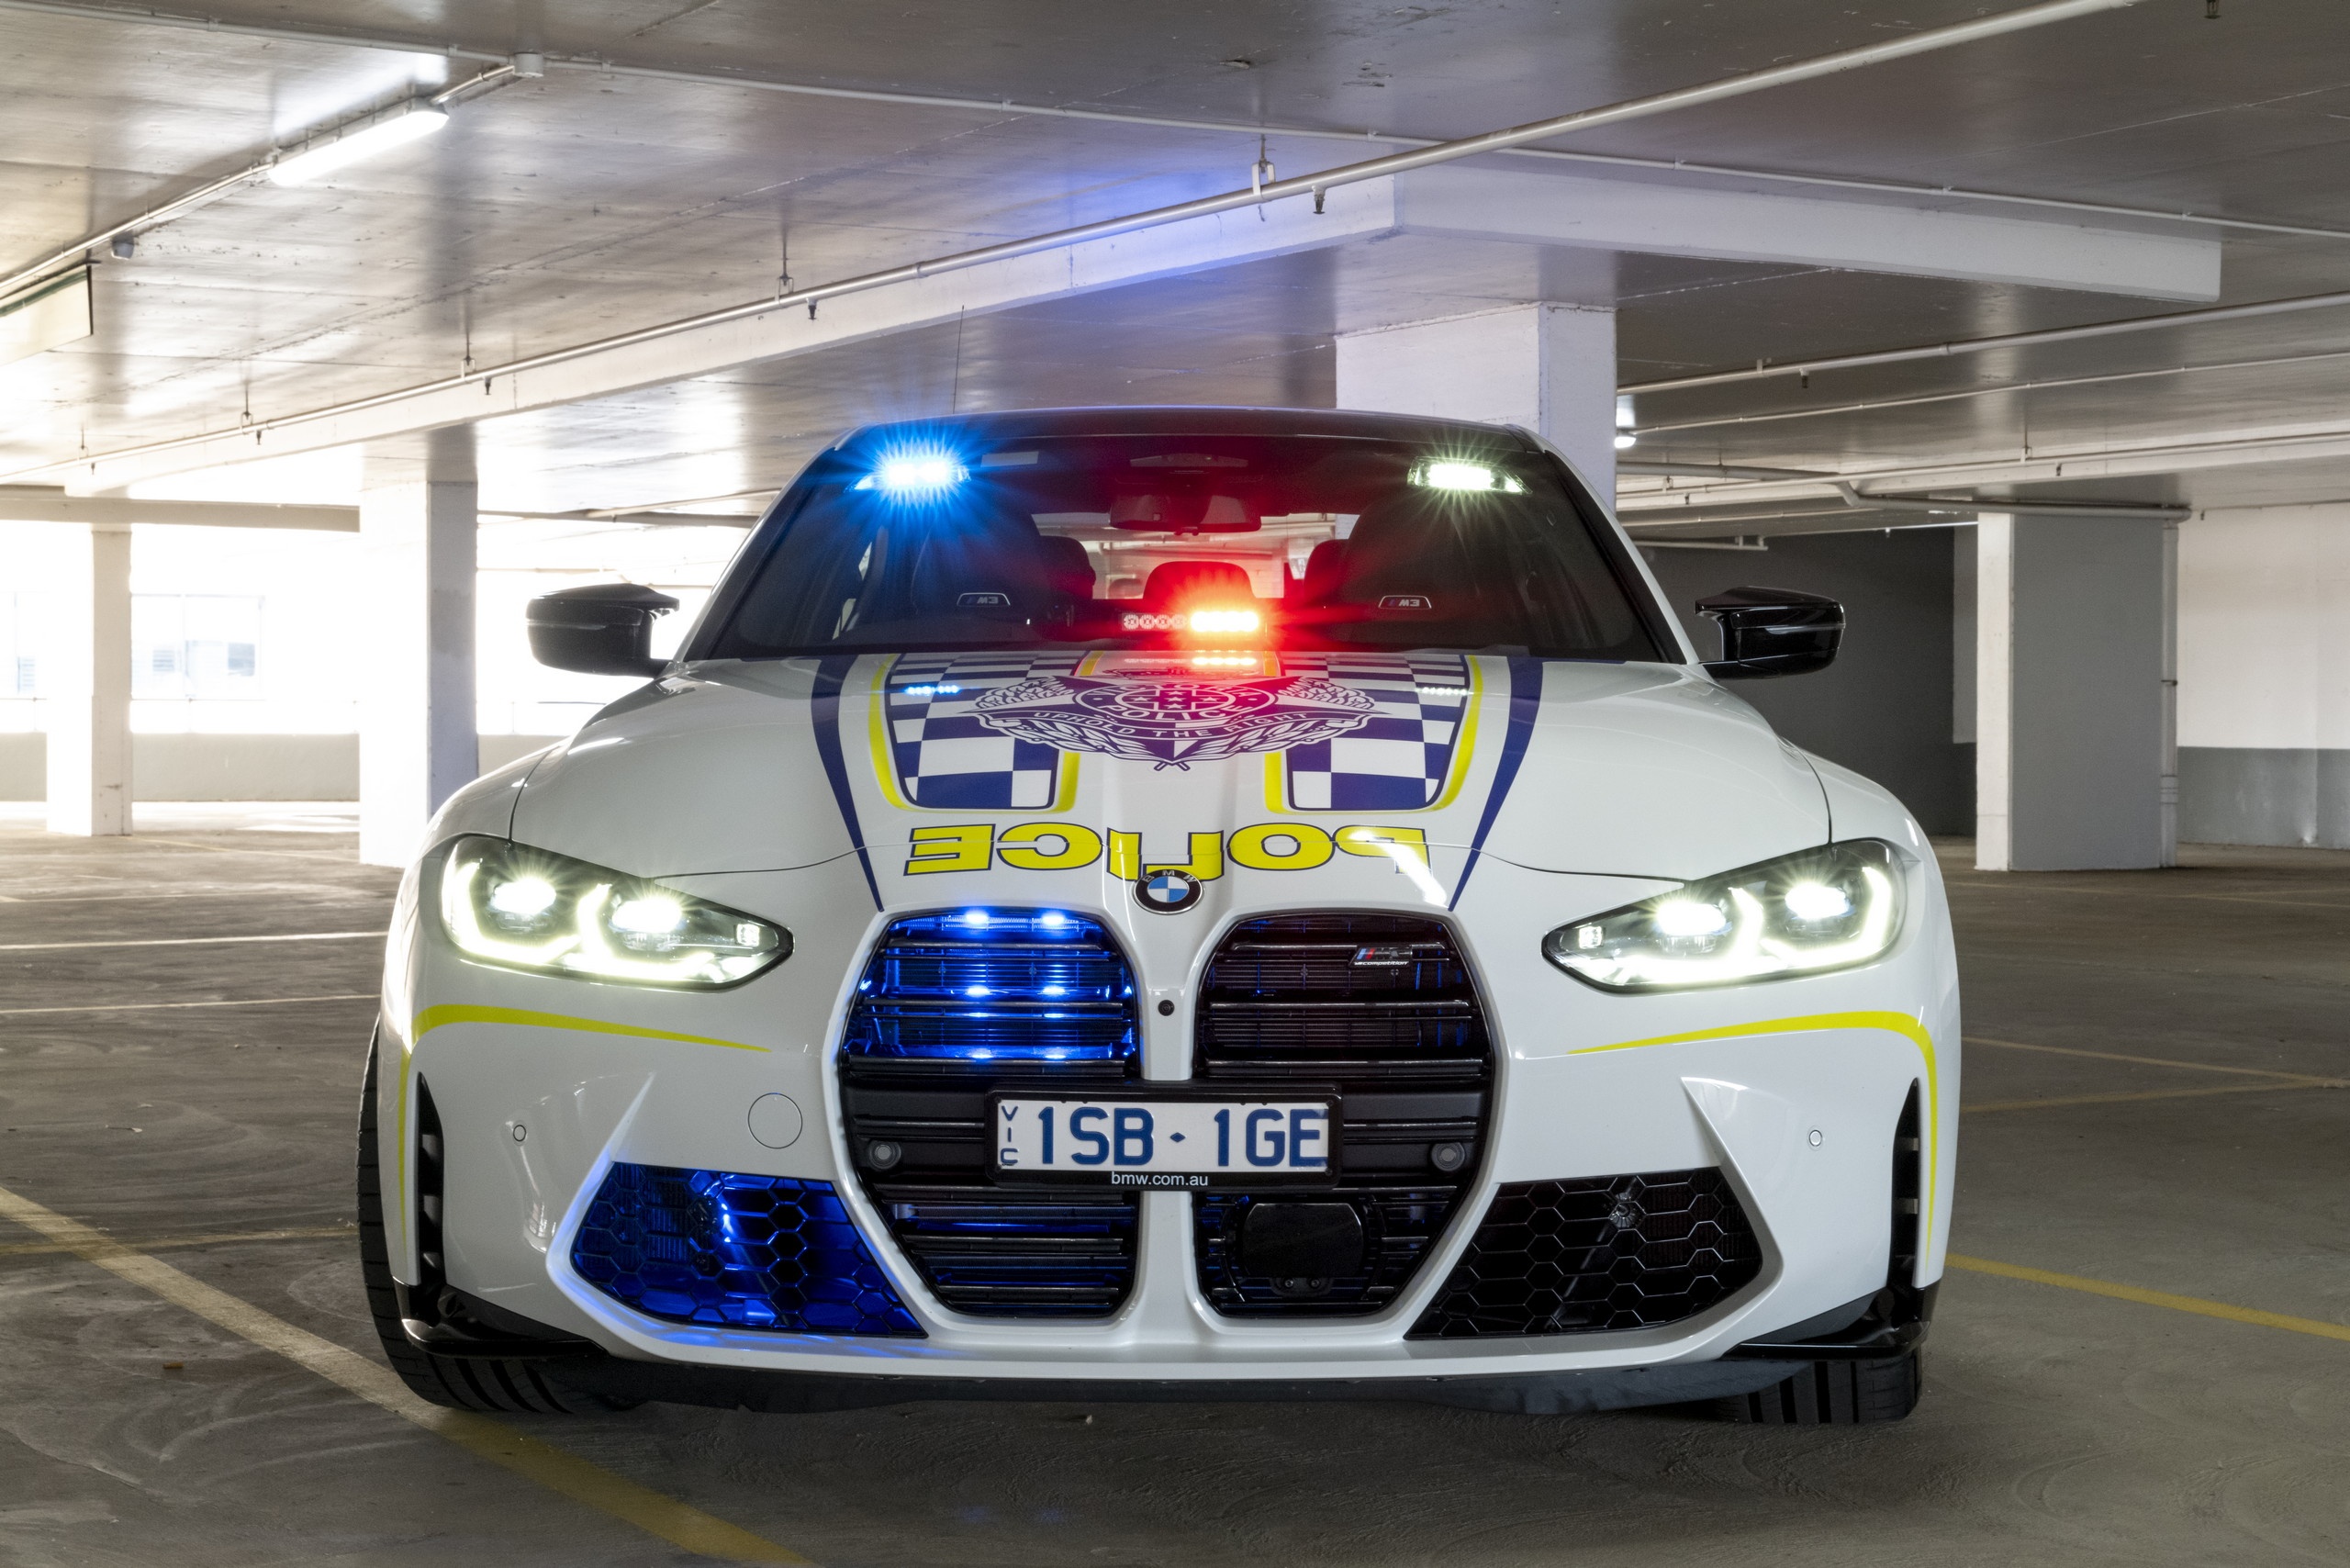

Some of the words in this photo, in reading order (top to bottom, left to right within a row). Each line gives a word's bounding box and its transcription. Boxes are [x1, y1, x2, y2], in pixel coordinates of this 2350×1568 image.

[1398, 599, 1420, 607] M3
[1097, 705, 1253, 721] POLICE
[1034, 711, 1136, 734] UPHOLD
[1224, 712, 1307, 733] RIGHT
[1141, 869, 1197, 882] BMW
[1000, 1105, 1019, 1165] VIC
[1037, 1105, 1155, 1166] 1SB
[1214, 1108, 1329, 1167] 1GE
[1111, 1171, 1208, 1186] bmw.com.au
